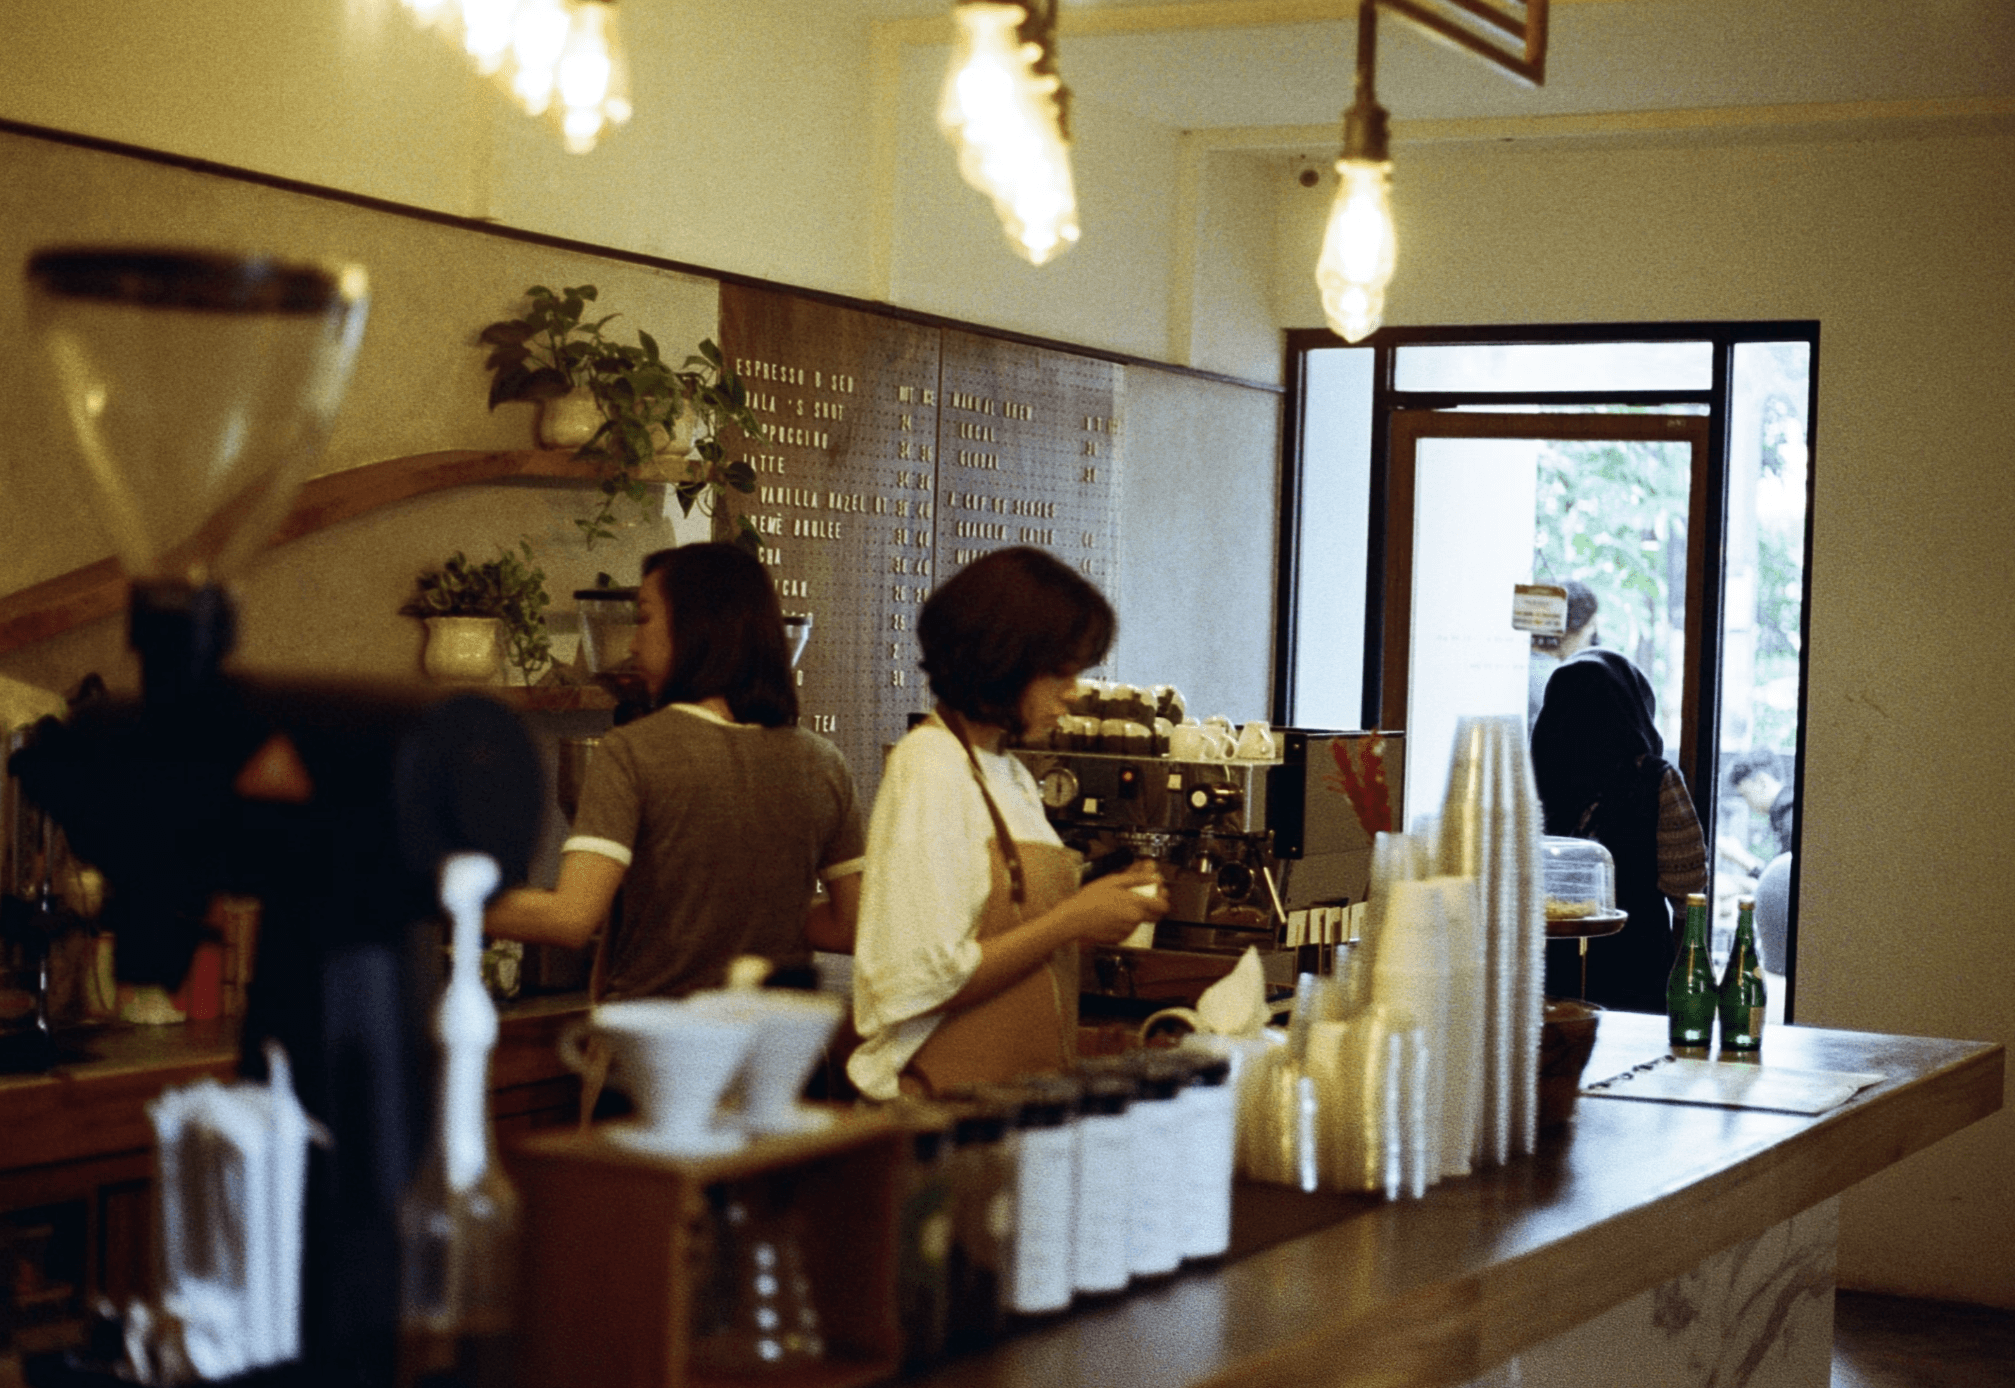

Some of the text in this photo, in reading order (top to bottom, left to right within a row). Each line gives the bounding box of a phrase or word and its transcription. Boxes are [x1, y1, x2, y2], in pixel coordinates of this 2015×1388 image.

[736, 358, 804, 386] ESPRESSO
[814, 401, 844, 421] SHOT
[744, 423, 828, 450] PPUCCINO
[960, 423, 995, 442] LOCAL
[960, 450, 1000, 470] GLOBAL
[761, 486, 818, 509] VANILLA
[829, 492, 866, 513] HAZEL
[814, 714, 835, 733] TEA
